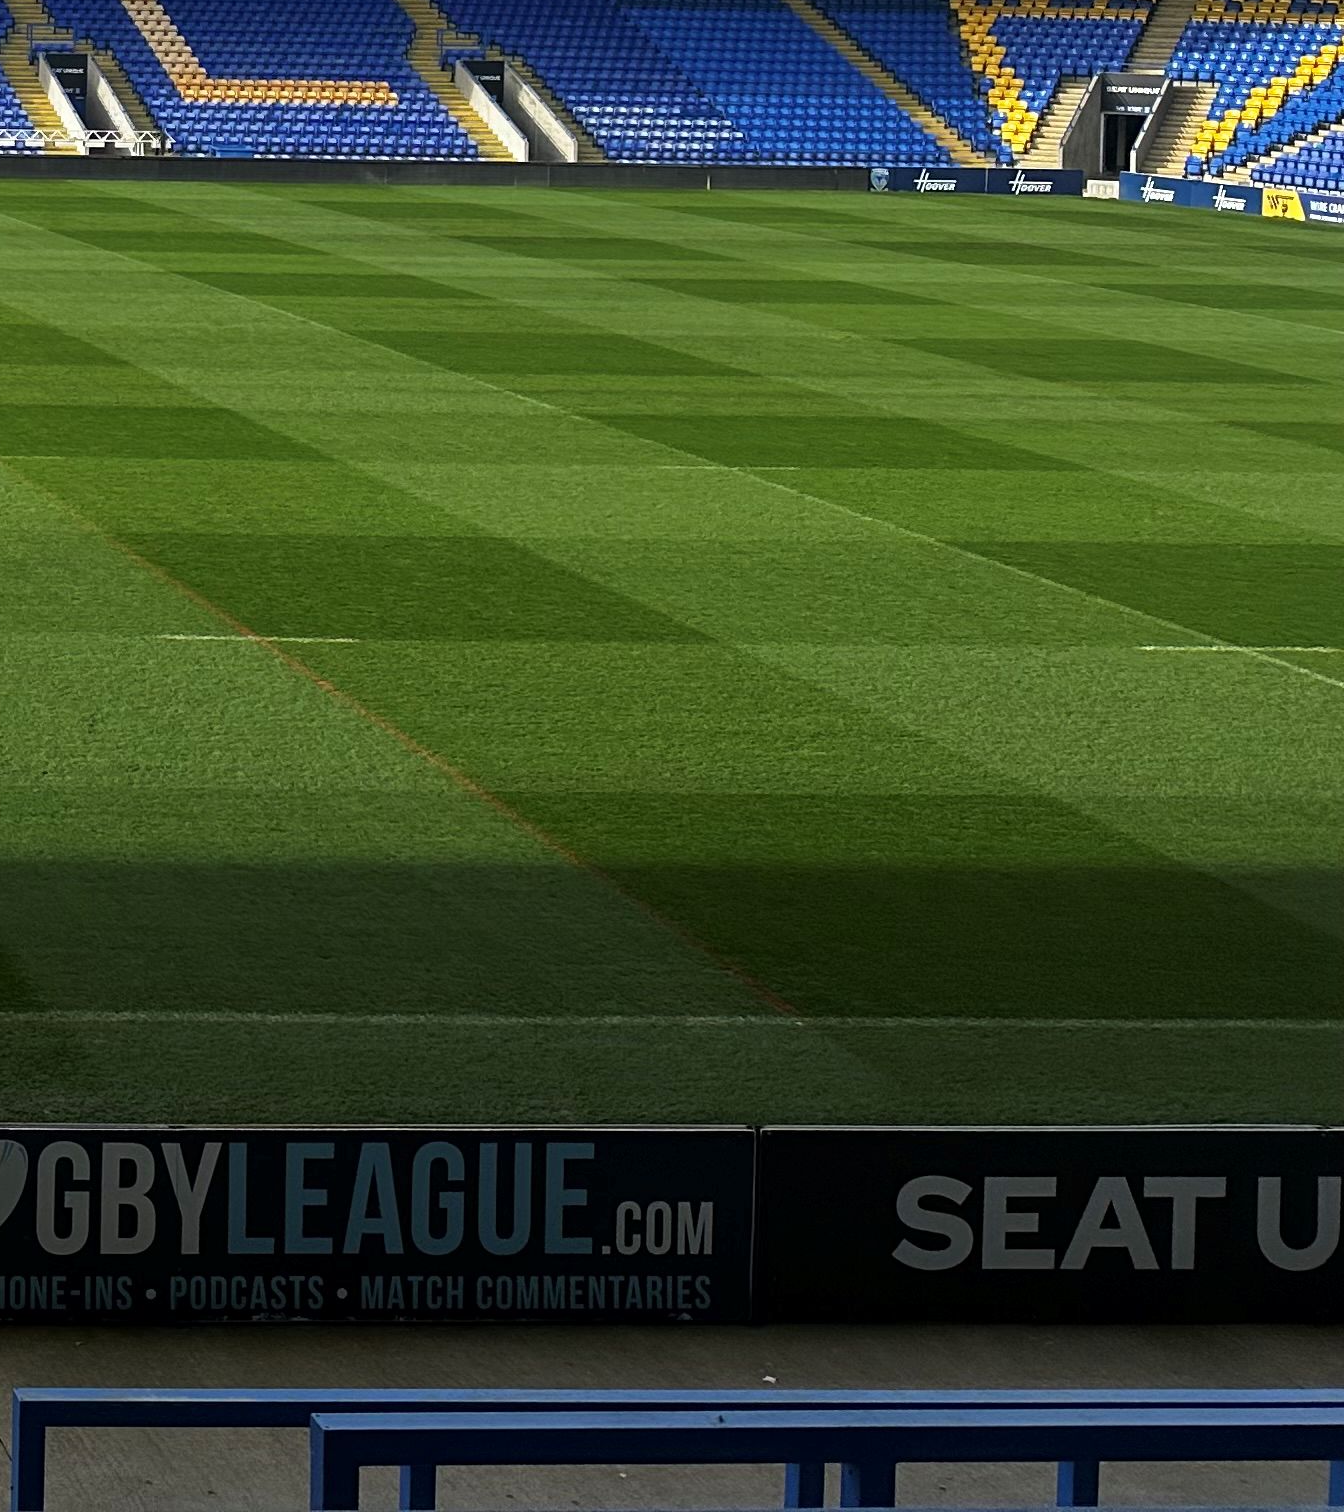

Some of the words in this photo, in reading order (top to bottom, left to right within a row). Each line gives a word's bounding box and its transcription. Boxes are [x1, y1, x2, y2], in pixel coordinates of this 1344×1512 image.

[913, 167, 957, 194] HOOVER
[1008, 169, 1054, 196] HOOVER
[891, 1175, 1227, 1271] SEAT
[170, 1275, 324, 1311] PODCASTS
[361, 1275, 464, 1311] MATCH
[476, 1275, 711, 1311] COMMENTARIES
